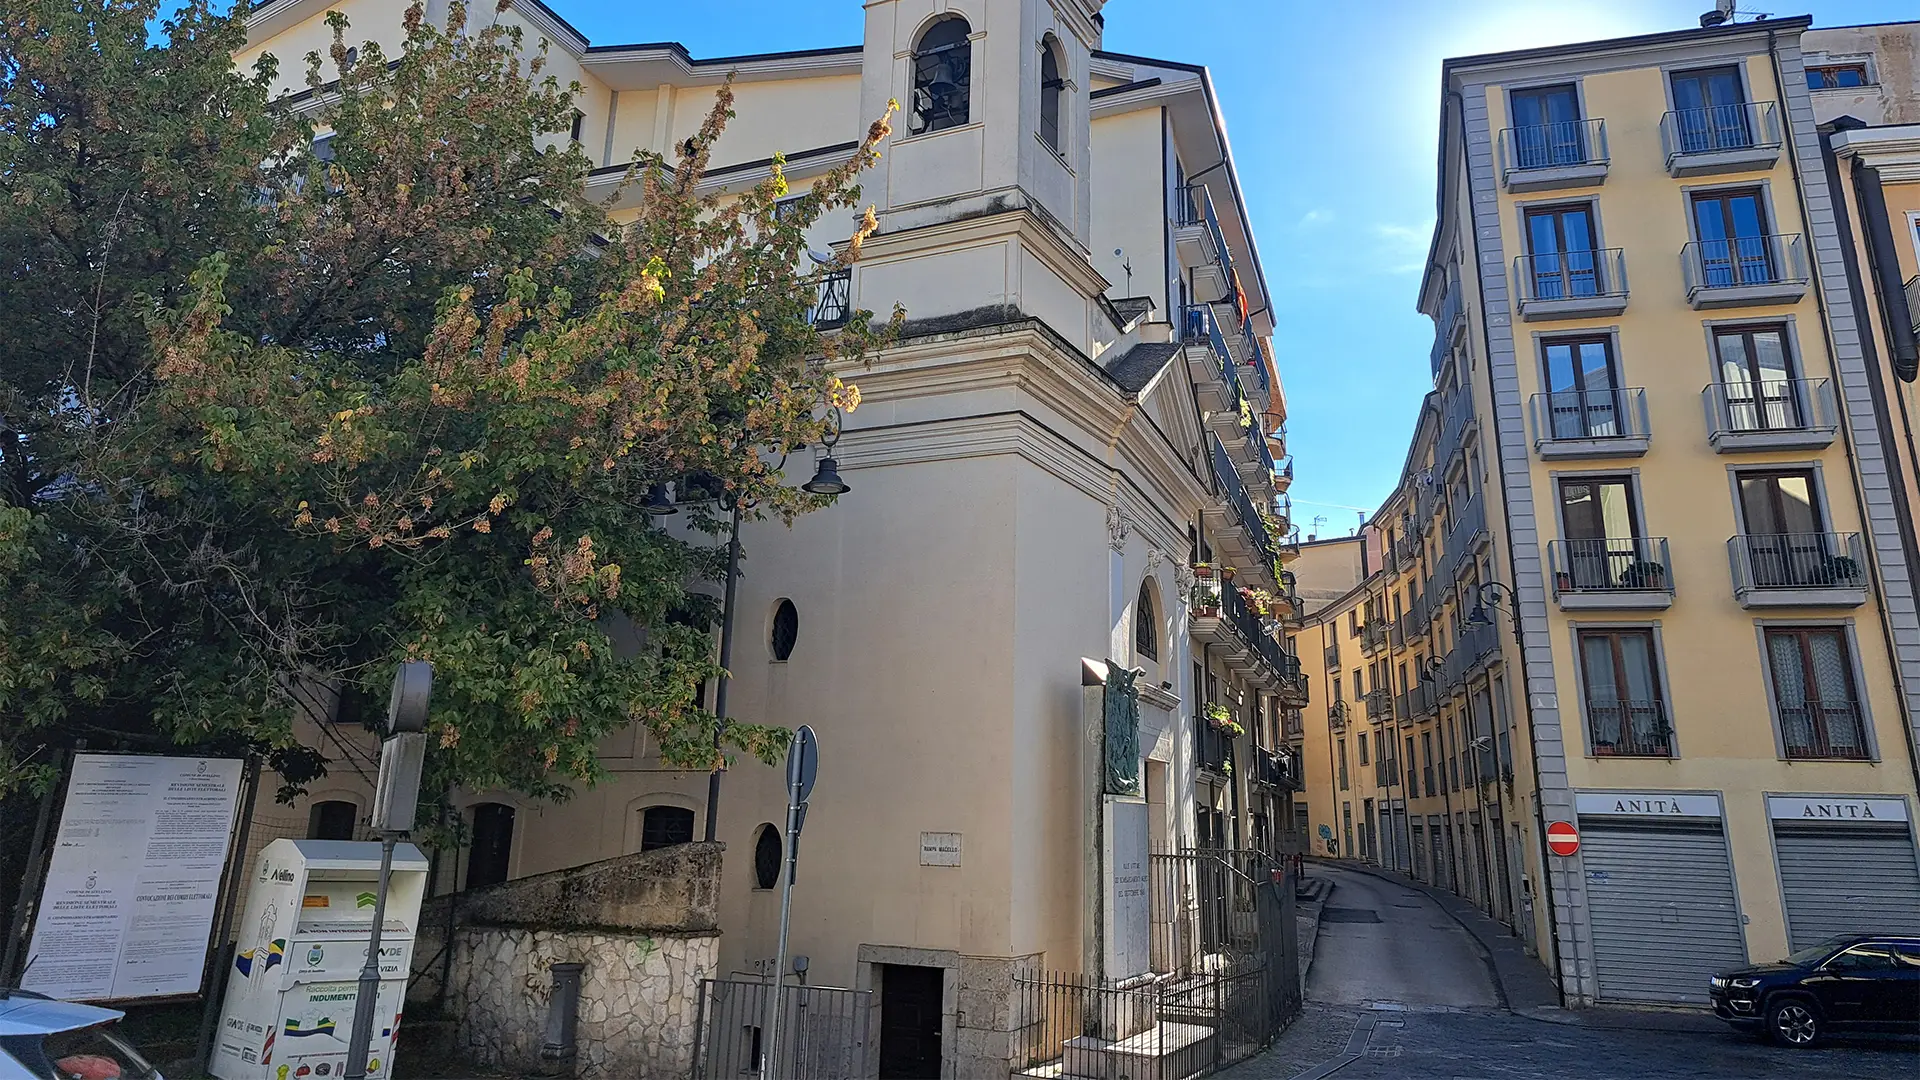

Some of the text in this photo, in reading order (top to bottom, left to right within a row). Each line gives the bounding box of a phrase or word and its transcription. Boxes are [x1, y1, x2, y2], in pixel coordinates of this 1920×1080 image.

[1614, 797, 1682, 813] ANITÀ
[1802, 801, 1876, 818] ANITÀ
[306, 985, 337, 993] Raccolta
[309, 993, 356, 1002] INDUMENTI
